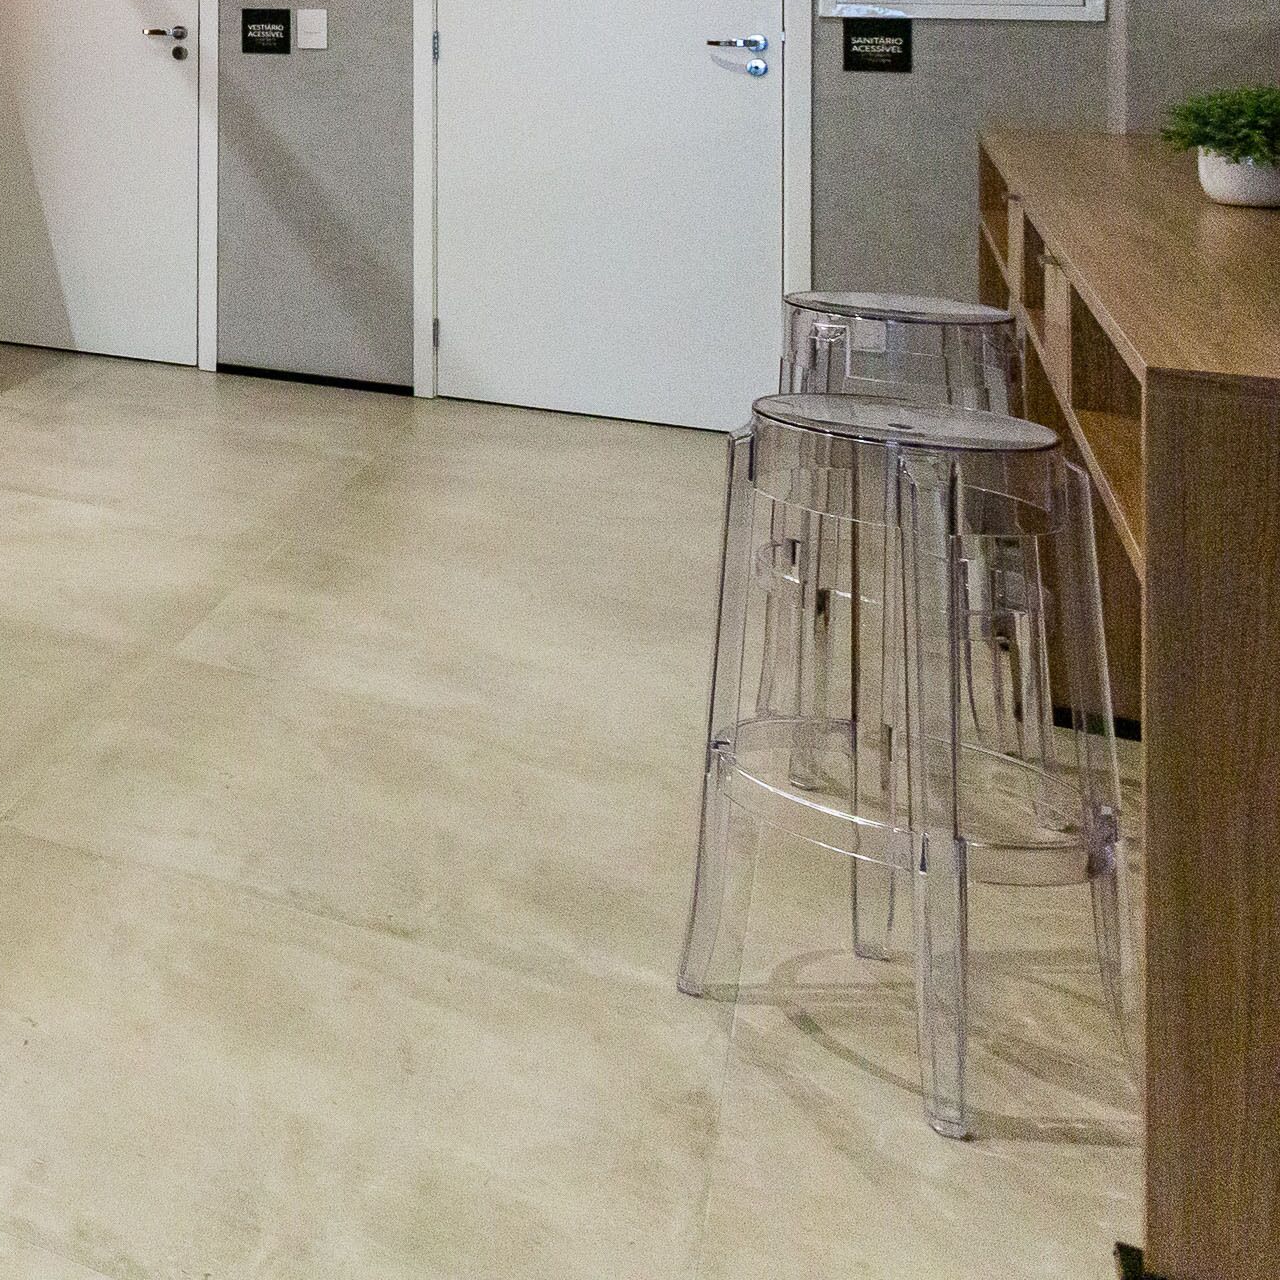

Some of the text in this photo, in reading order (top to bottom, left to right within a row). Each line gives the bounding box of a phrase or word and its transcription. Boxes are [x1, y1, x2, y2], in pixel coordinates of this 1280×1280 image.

[247, 22, 284, 31] VESTIÁRIO
[247, 30, 284, 39] ACESSÍVEL
[850, 36, 904, 46] SANITÁRIO
[851, 45, 903, 54] ACESSÍVEL
